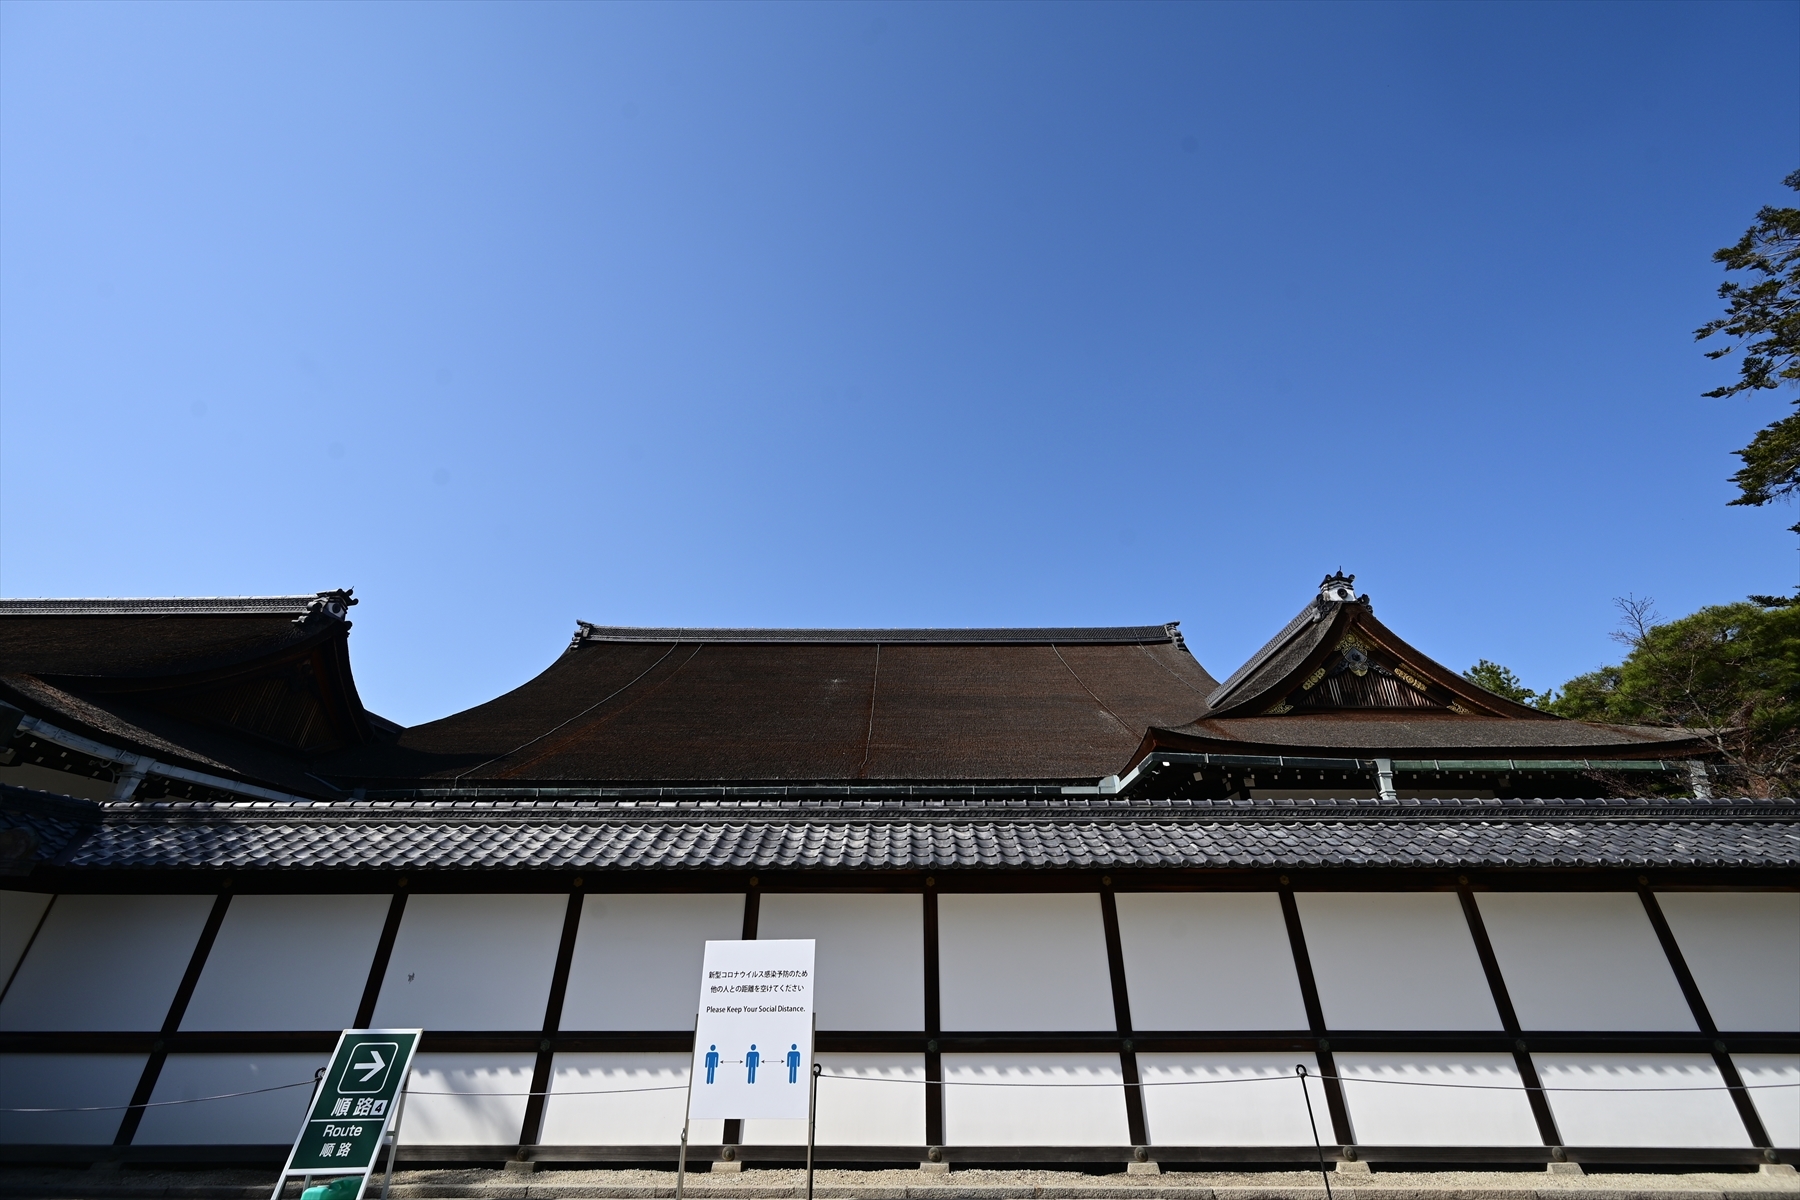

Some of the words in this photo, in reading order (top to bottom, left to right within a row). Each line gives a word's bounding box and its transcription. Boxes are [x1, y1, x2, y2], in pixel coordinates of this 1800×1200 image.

[708, 970, 808, 979] 新型コロナウイルス感染予防のため
[710, 984, 805, 993] 他の人との距離を空けてください
[727, 1006, 742, 1014] Keep
[759, 1005, 777, 1013] Social
[331, 1097, 373, 1117] 順路
[322, 1124, 363, 1137] Route
